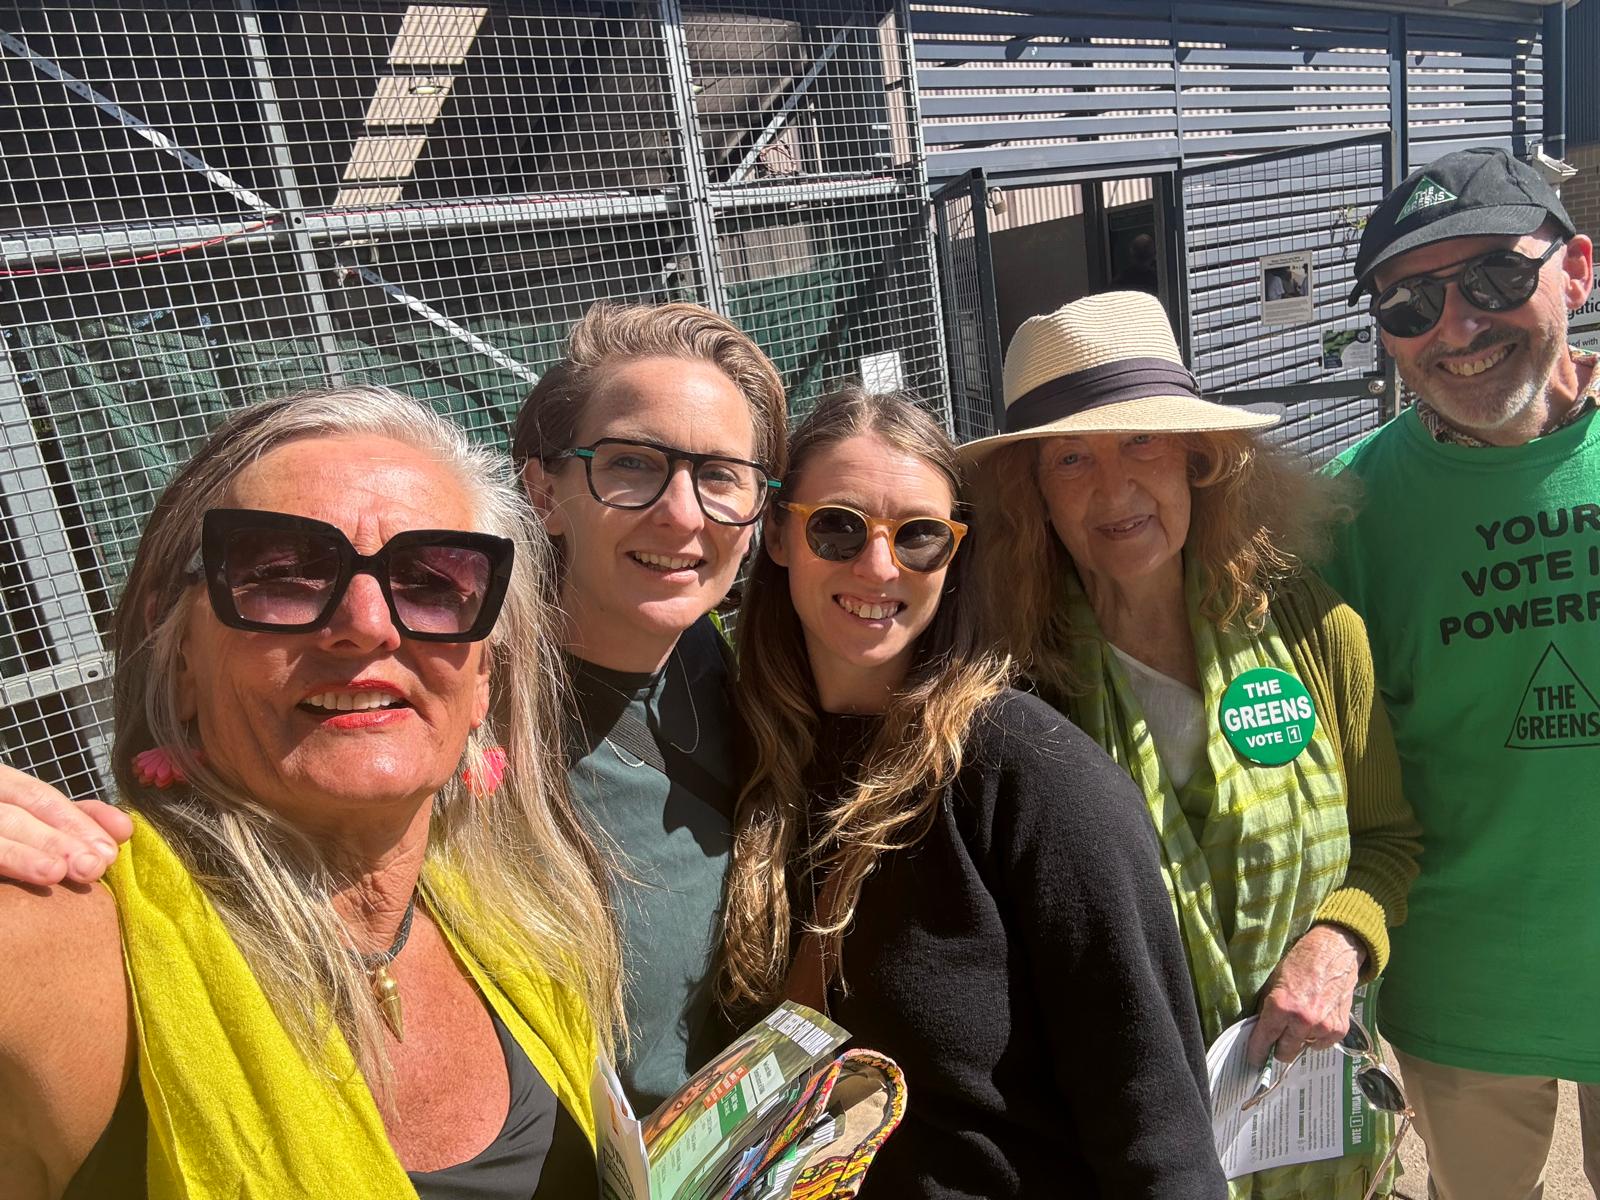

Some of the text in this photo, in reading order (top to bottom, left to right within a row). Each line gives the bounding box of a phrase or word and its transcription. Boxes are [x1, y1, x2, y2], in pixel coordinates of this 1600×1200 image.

[1404, 191, 1445, 214] GREENS
[1415, 186, 1435, 200] THE
[1582, 338, 1598, 346] with
[1476, 503, 1600, 550] YOUR
[1461, 550, 1574, 597] VOTE
[1242, 678, 1282, 699] THE
[1533, 684, 1576, 711] THE
[1224, 695, 1312, 732] GREENS
[1517, 711, 1600, 740] GREENS
[1245, 731, 1284, 748] VOTE
[1351, 1127, 1361, 1144] VOTE
